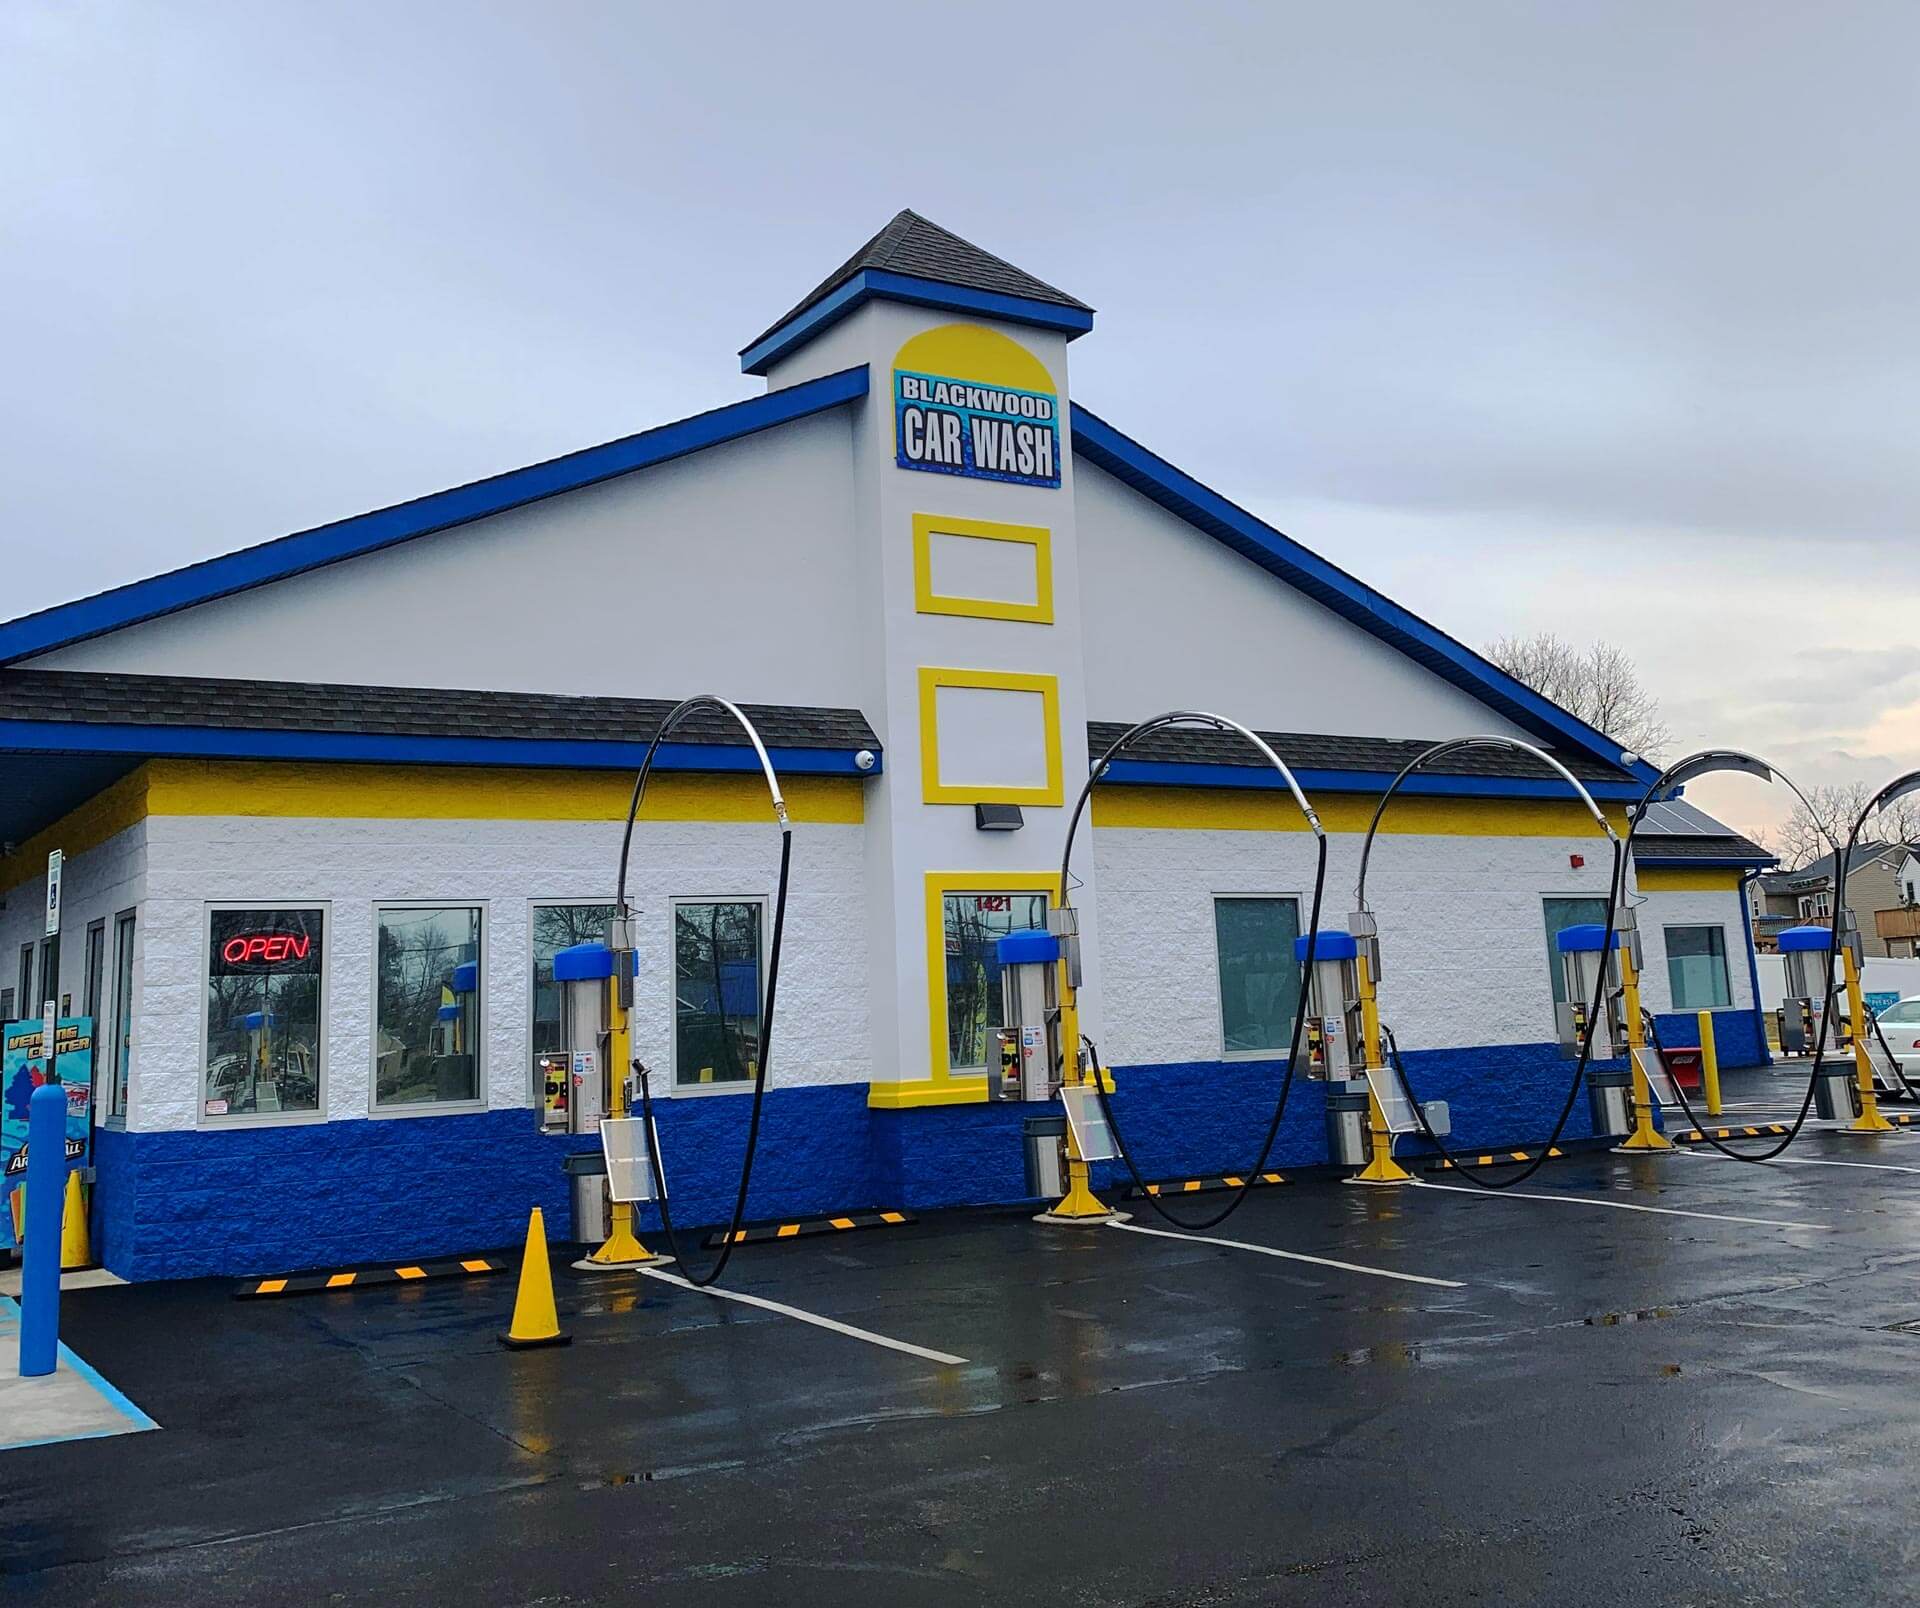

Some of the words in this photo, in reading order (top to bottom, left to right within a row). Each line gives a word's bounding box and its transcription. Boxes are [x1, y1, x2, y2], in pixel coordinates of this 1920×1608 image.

[902, 376, 1052, 420] BLACKWOOD
[904, 407, 963, 465] CAR
[971, 417, 1053, 477] WASH
[976, 896, 1011, 912] 1421
[223, 935, 309, 962] OPEN
[9, 1026, 78, 1049] VENNG
[28, 1038, 90, 1059] CTER
